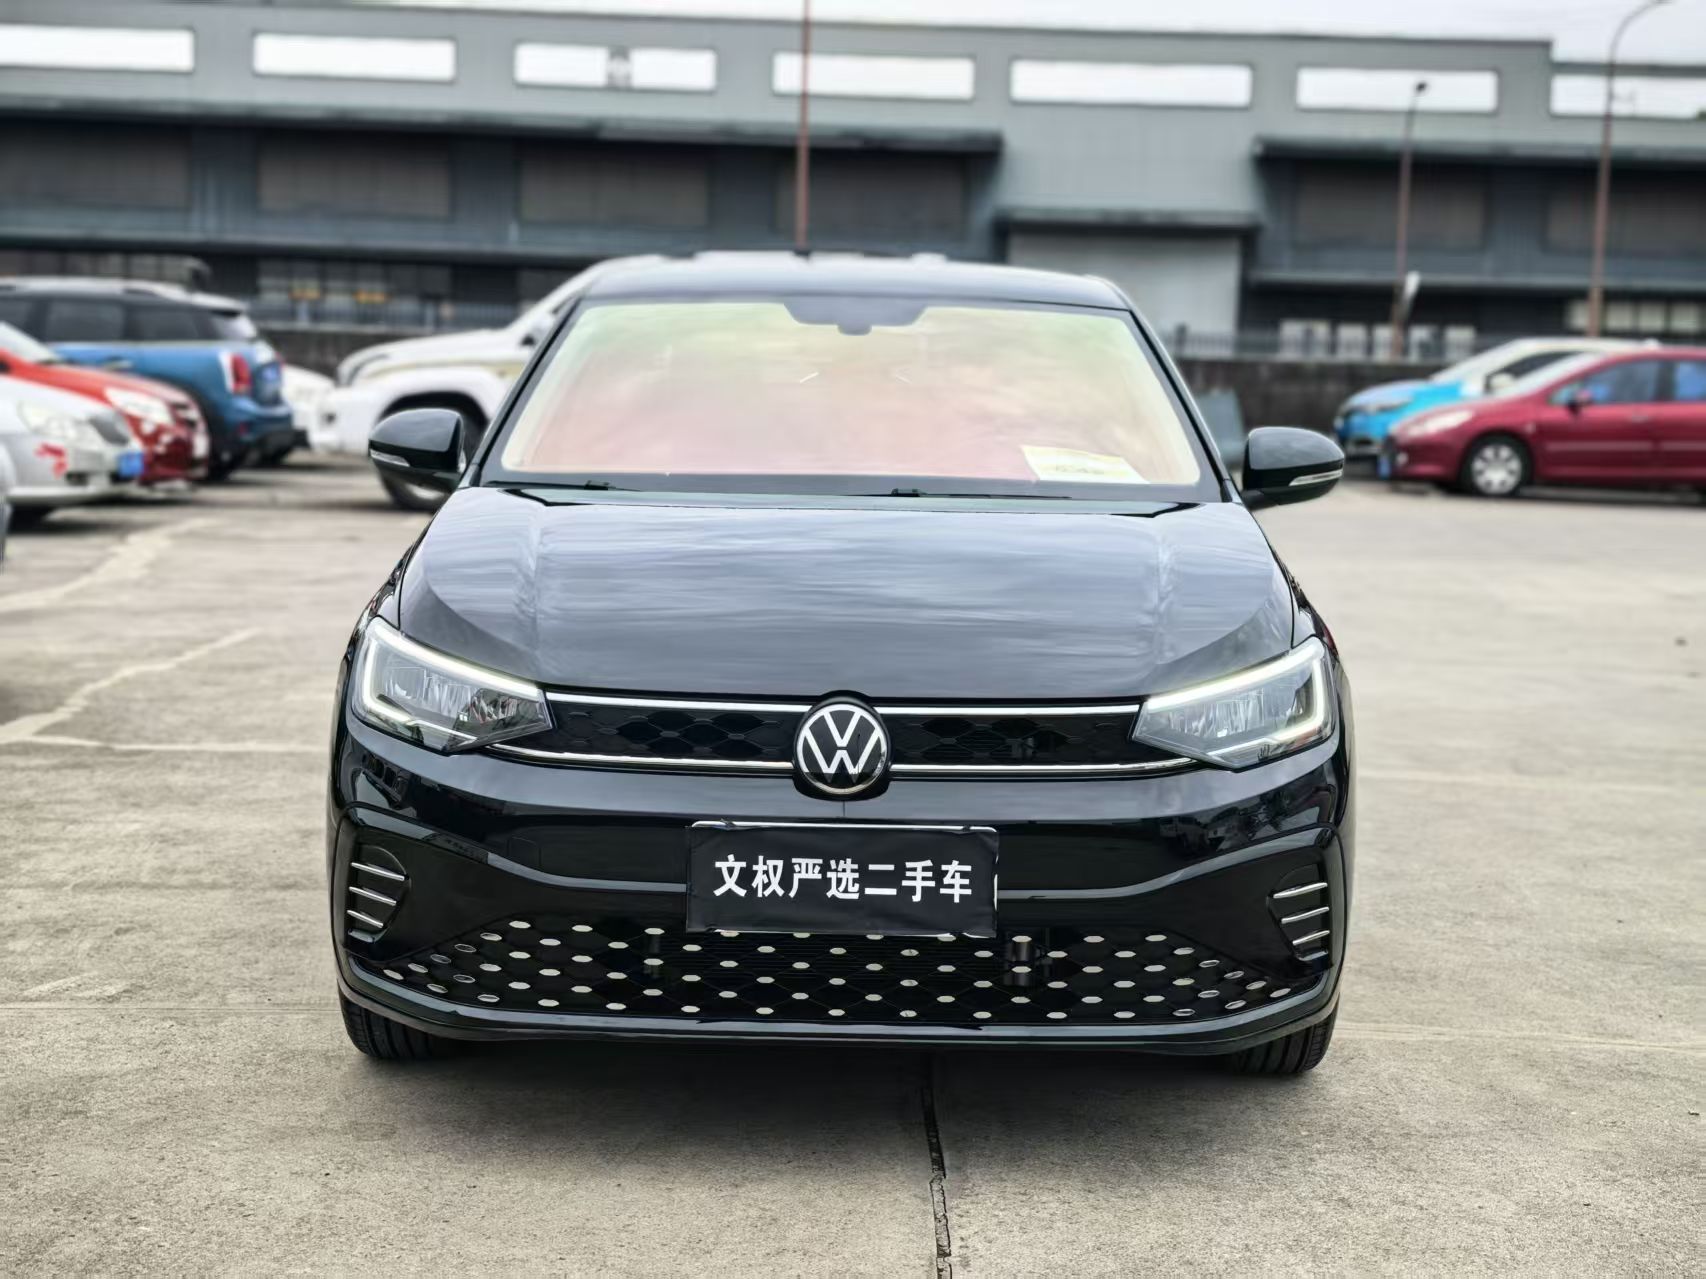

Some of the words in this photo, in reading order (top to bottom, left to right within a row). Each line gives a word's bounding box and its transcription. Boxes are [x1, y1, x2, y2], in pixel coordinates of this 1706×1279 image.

[713, 854, 972, 903] 文权严选二手车
